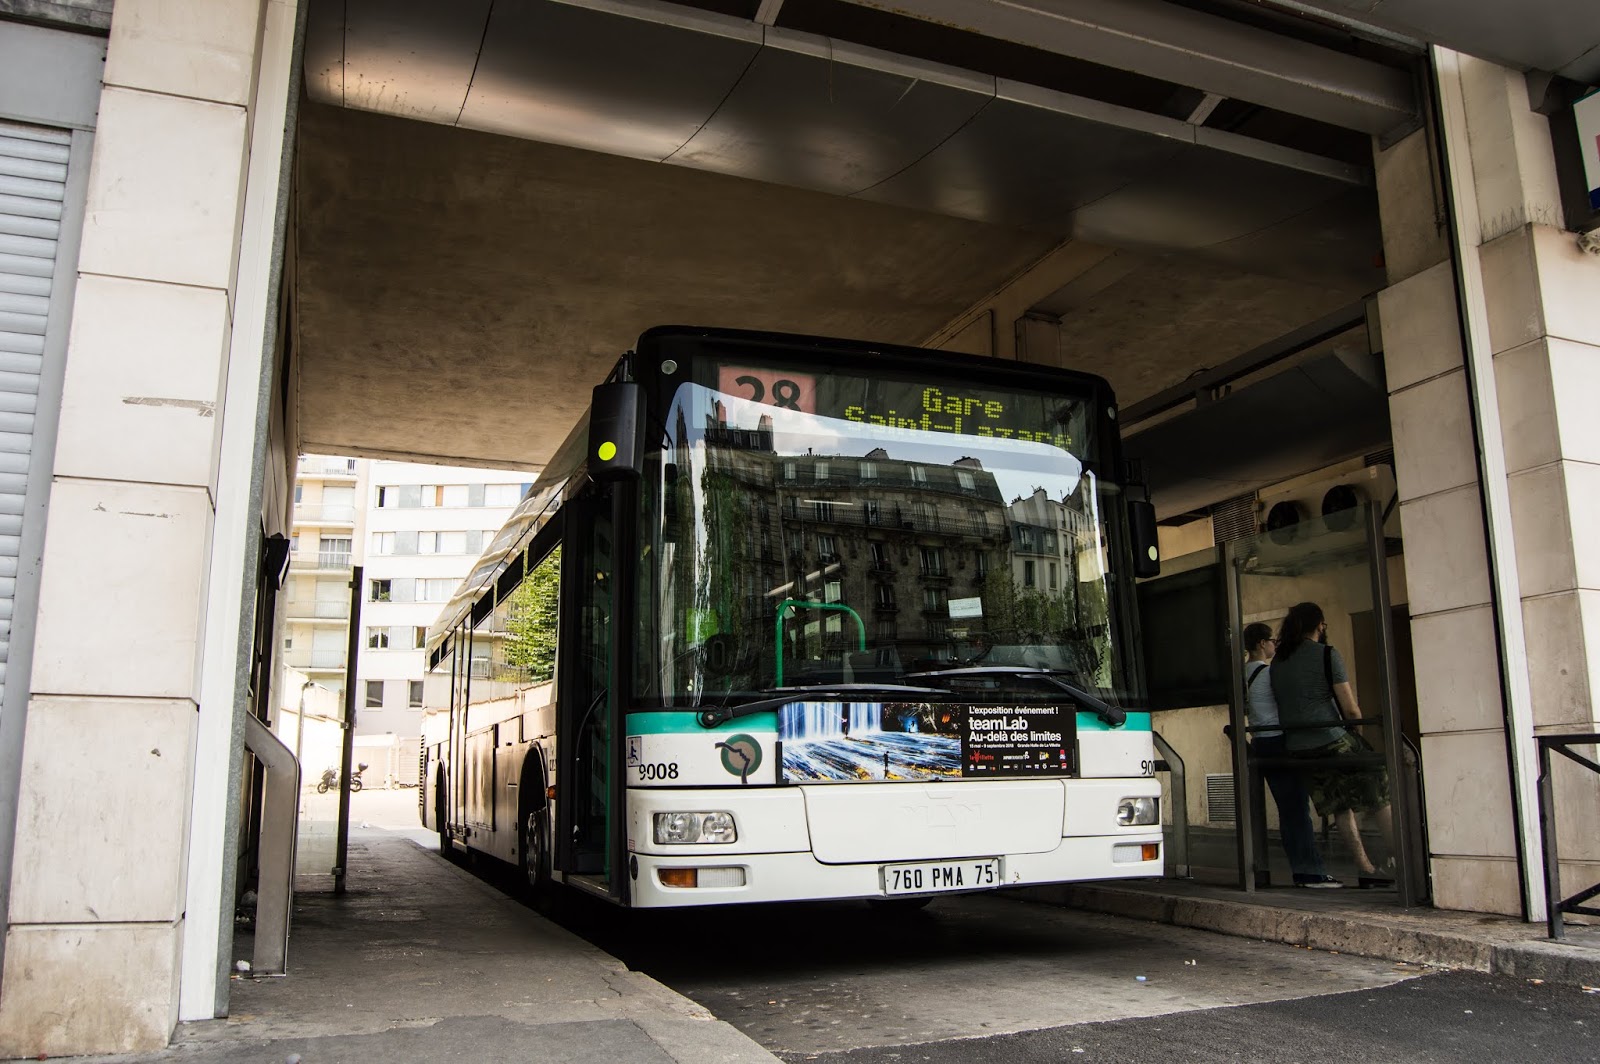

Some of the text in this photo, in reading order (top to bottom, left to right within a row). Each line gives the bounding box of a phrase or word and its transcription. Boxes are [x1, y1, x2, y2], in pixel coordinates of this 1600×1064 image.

[735, 375, 801, 412] 28
[922, 387, 1003, 419] Gare
[845, 405, 1072, 450] Saint-Lazare
[1014, 706, 1055, 714] événement
[968, 716, 1028, 730] teamLab
[969, 731, 1061, 741] Au-delà des limites
[639, 763, 679, 780] 9008
[1141, 759, 1154, 775] 90
[893, 865, 993, 890] 760 PMA 75
